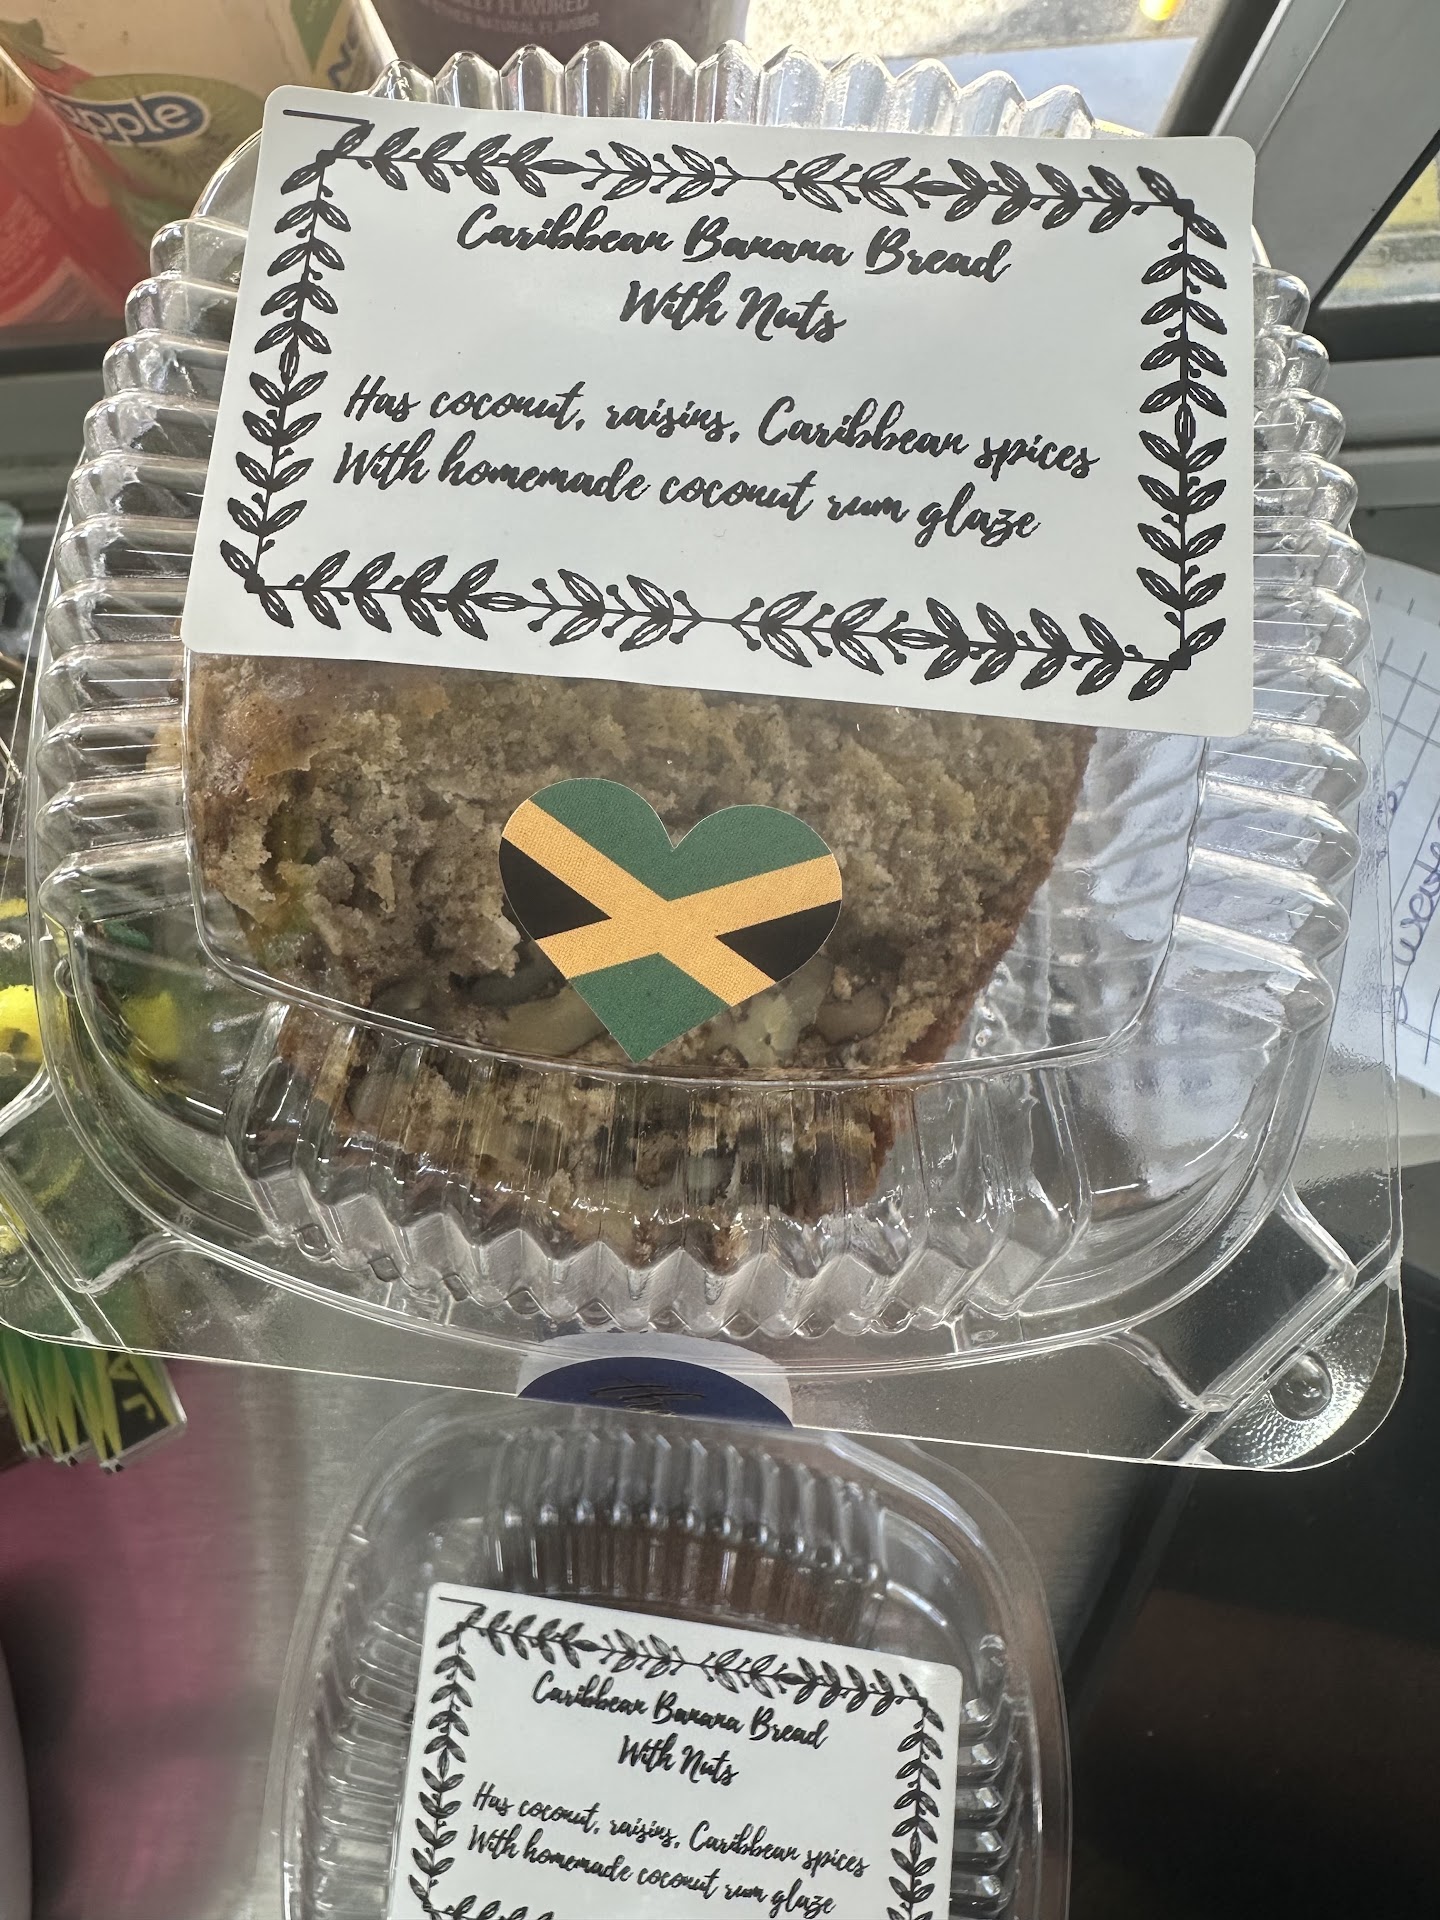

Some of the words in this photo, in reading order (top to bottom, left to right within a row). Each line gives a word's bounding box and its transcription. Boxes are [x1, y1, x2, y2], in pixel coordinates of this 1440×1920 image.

[457, 203, 674, 254] Caribbean
[682, 215, 854, 266] Banana
[864, 225, 1012, 283] Bread
[619, 271, 732, 331] With
[735, 286, 847, 343] Nuts
[343, 374, 421, 422] Has
[430, 381, 585, 431] coconut,
[605, 398, 740, 443] raisins,
[758, 395, 969, 458] Caribbean
[973, 435, 1100, 482] spices
[333, 428, 435, 490] With
[438, 430, 651, 502] homemade
[659, 470, 817, 521] coconut
[827, 494, 910, 523] rum
[914, 482, 1041, 547] glaze
[531, 1670, 649, 1716] Caribbean
[651, 1690, 745, 1734] Banana
[749, 1706, 829, 1749] Bread
[617, 1733, 679, 1773] With
[679, 1745, 739, 1786] Nuts
[467, 1823, 523, 1860] With
[523, 1827, 634, 1882] homemade
[637, 1867, 720, 1900] coconut
[724, 1884, 769, 1903] rum
[769, 1878, 837, 1920] glaze
[472, 1781, 514, 1817] Has
[518, 1800, 600, 1834] coconut,
[609, 1817, 681, 1849] raisins,
[689, 1820, 801, 1862] Caribbean
[802, 1849, 870, 1878] spices
